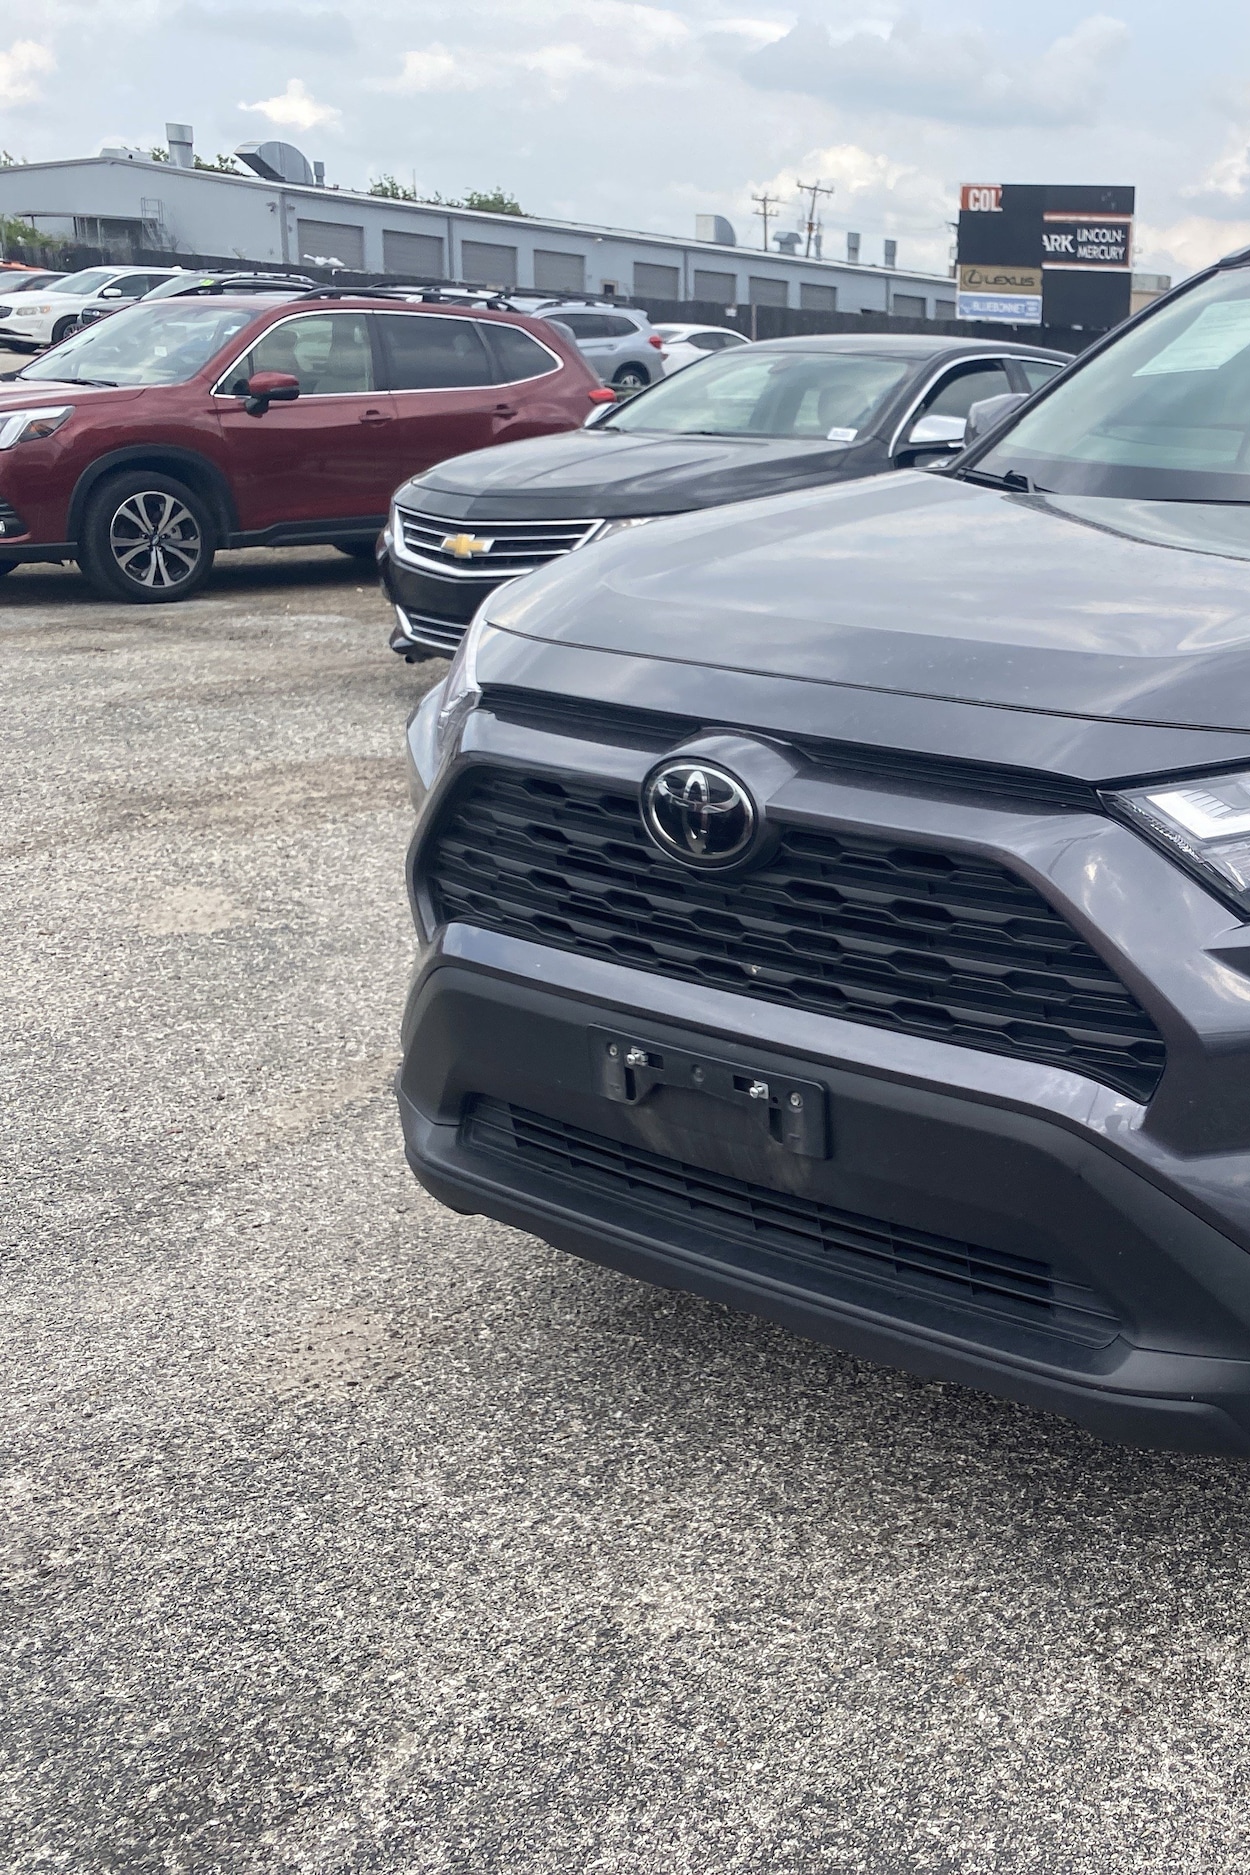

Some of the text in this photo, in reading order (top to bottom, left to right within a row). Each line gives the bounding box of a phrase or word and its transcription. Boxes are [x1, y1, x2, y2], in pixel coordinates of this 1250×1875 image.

[969, 188, 1003, 212] COL
[1077, 228, 1125, 243] LINCOLN-
[1077, 245, 1126, 260] MERCURY
[985, 274, 1035, 287] LEXUS
